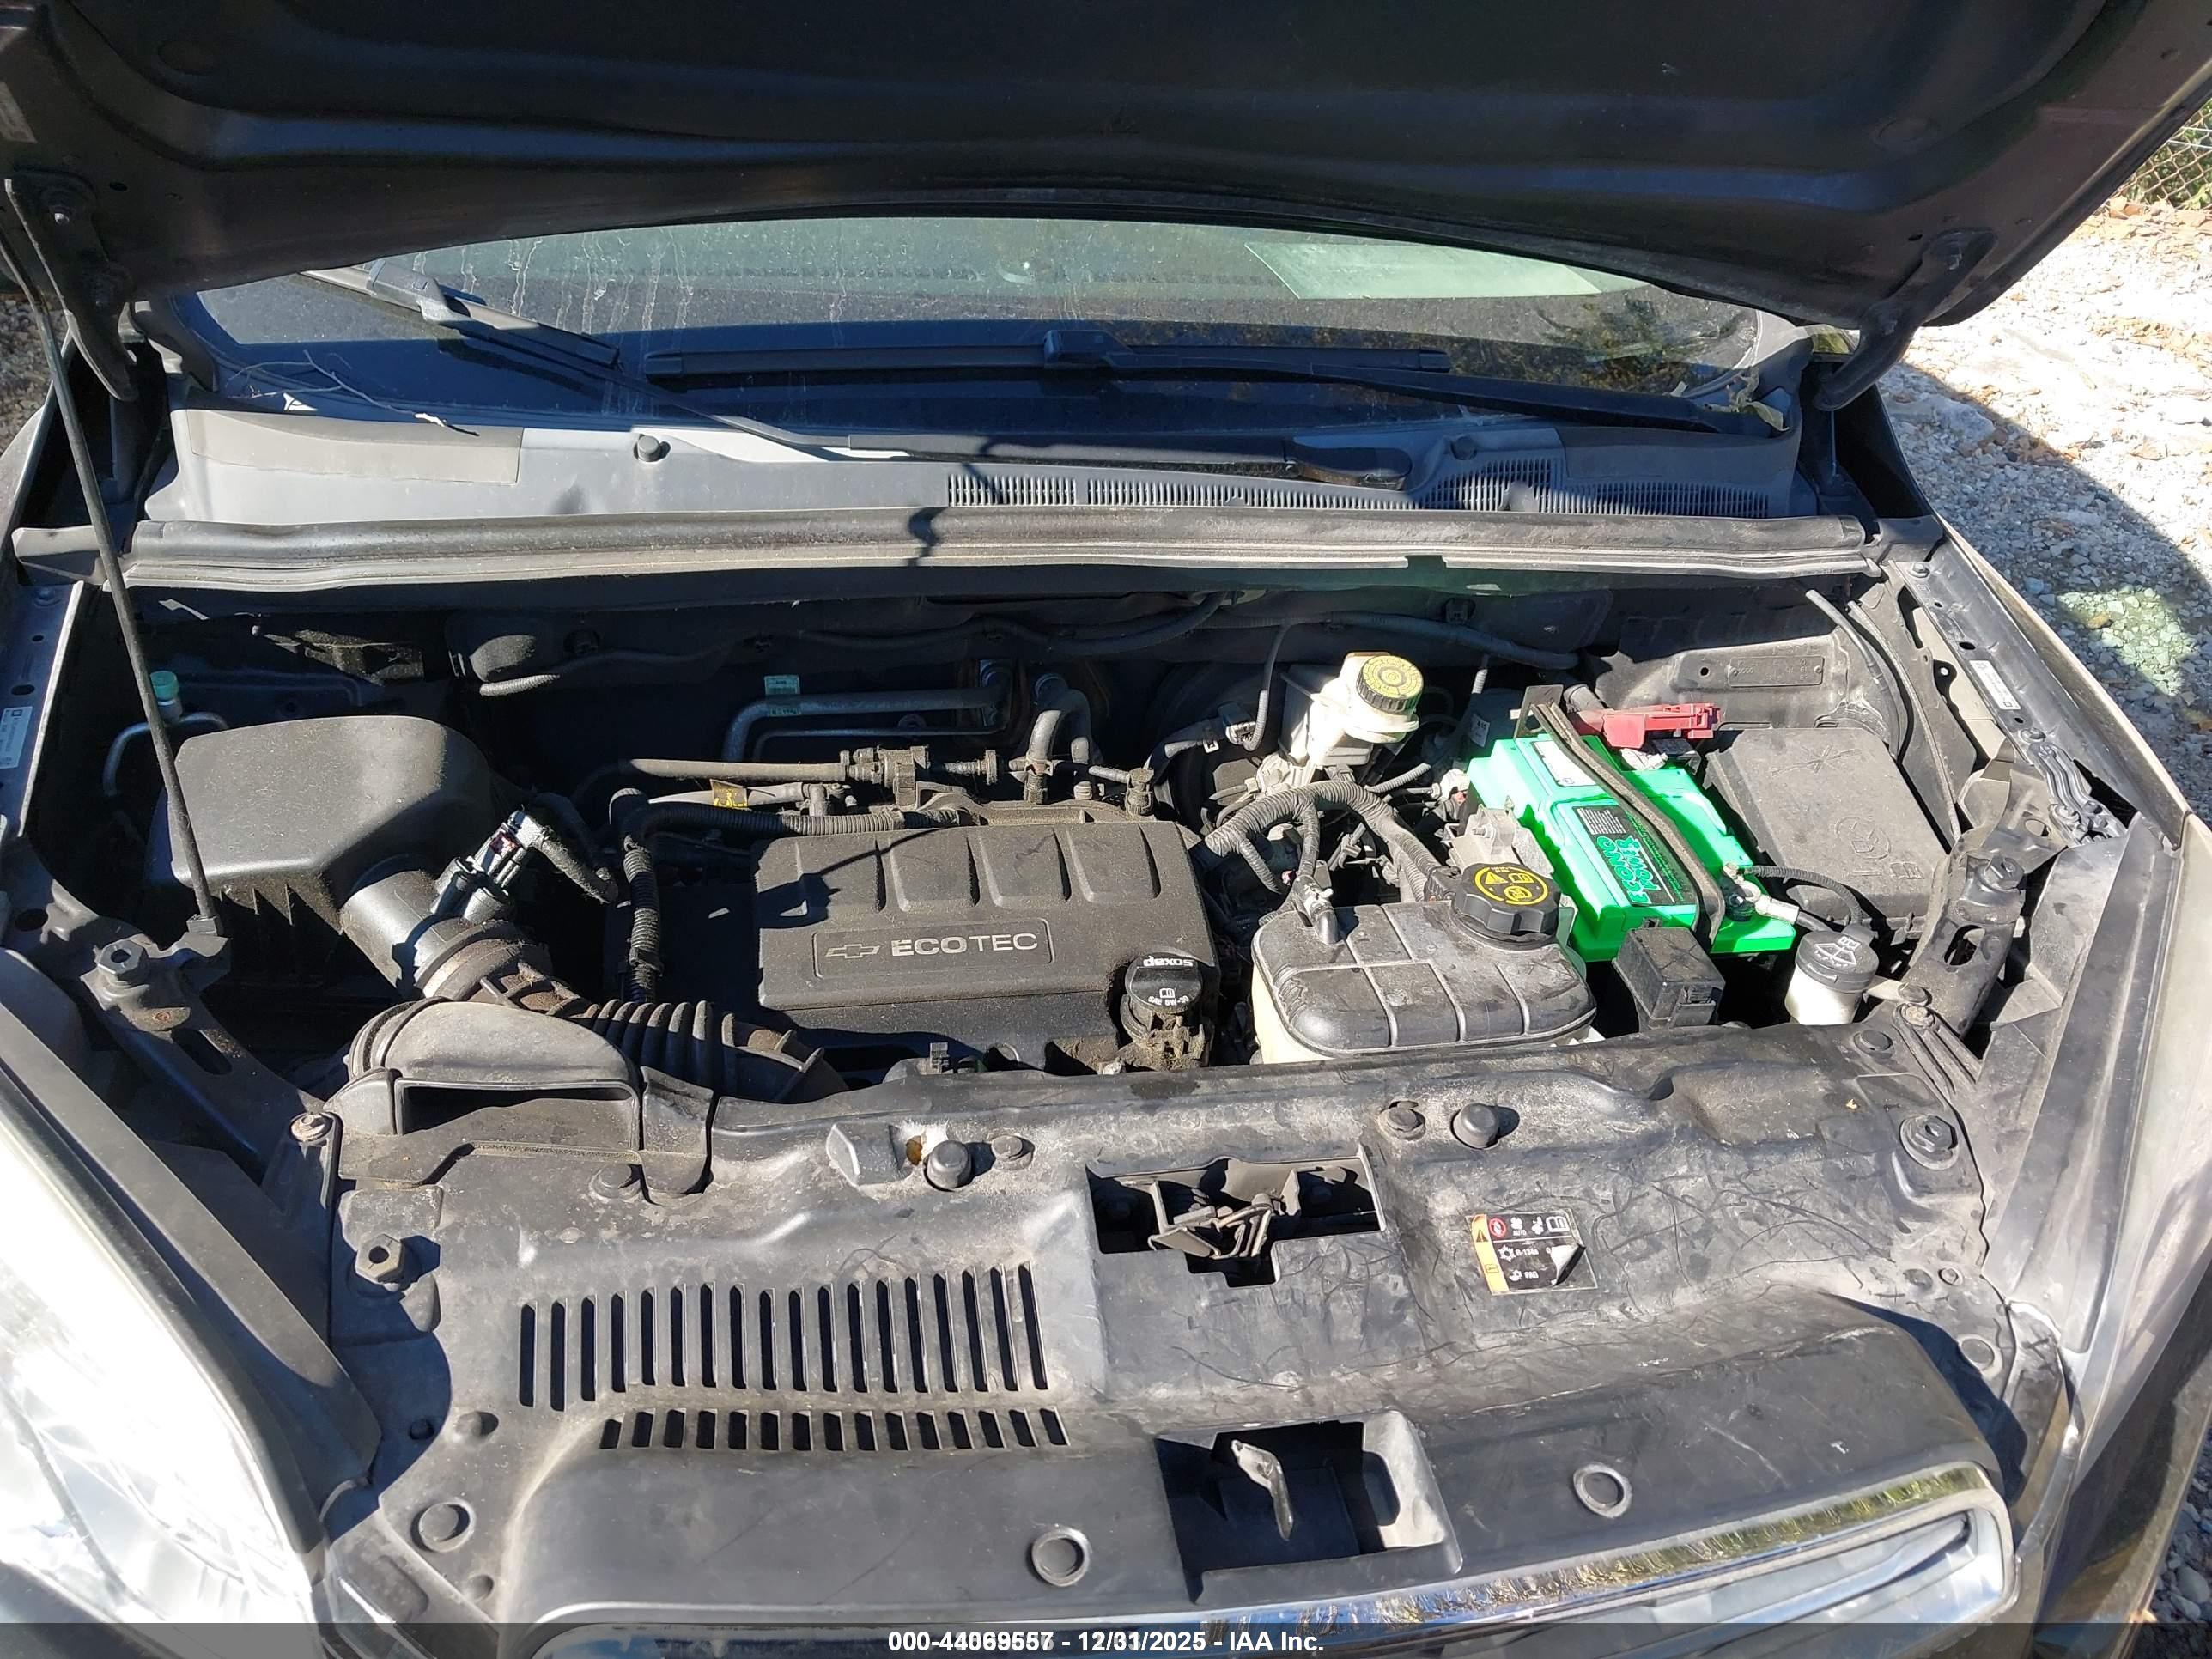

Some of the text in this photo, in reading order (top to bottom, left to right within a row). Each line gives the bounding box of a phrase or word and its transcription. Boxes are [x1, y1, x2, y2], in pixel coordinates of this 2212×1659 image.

[1597, 836, 1652, 904] ECONO
[1614, 835, 1662, 890] POWER
[890, 933, 1038, 957] ECOTEC
[1143, 955, 1194, 967] dexos
